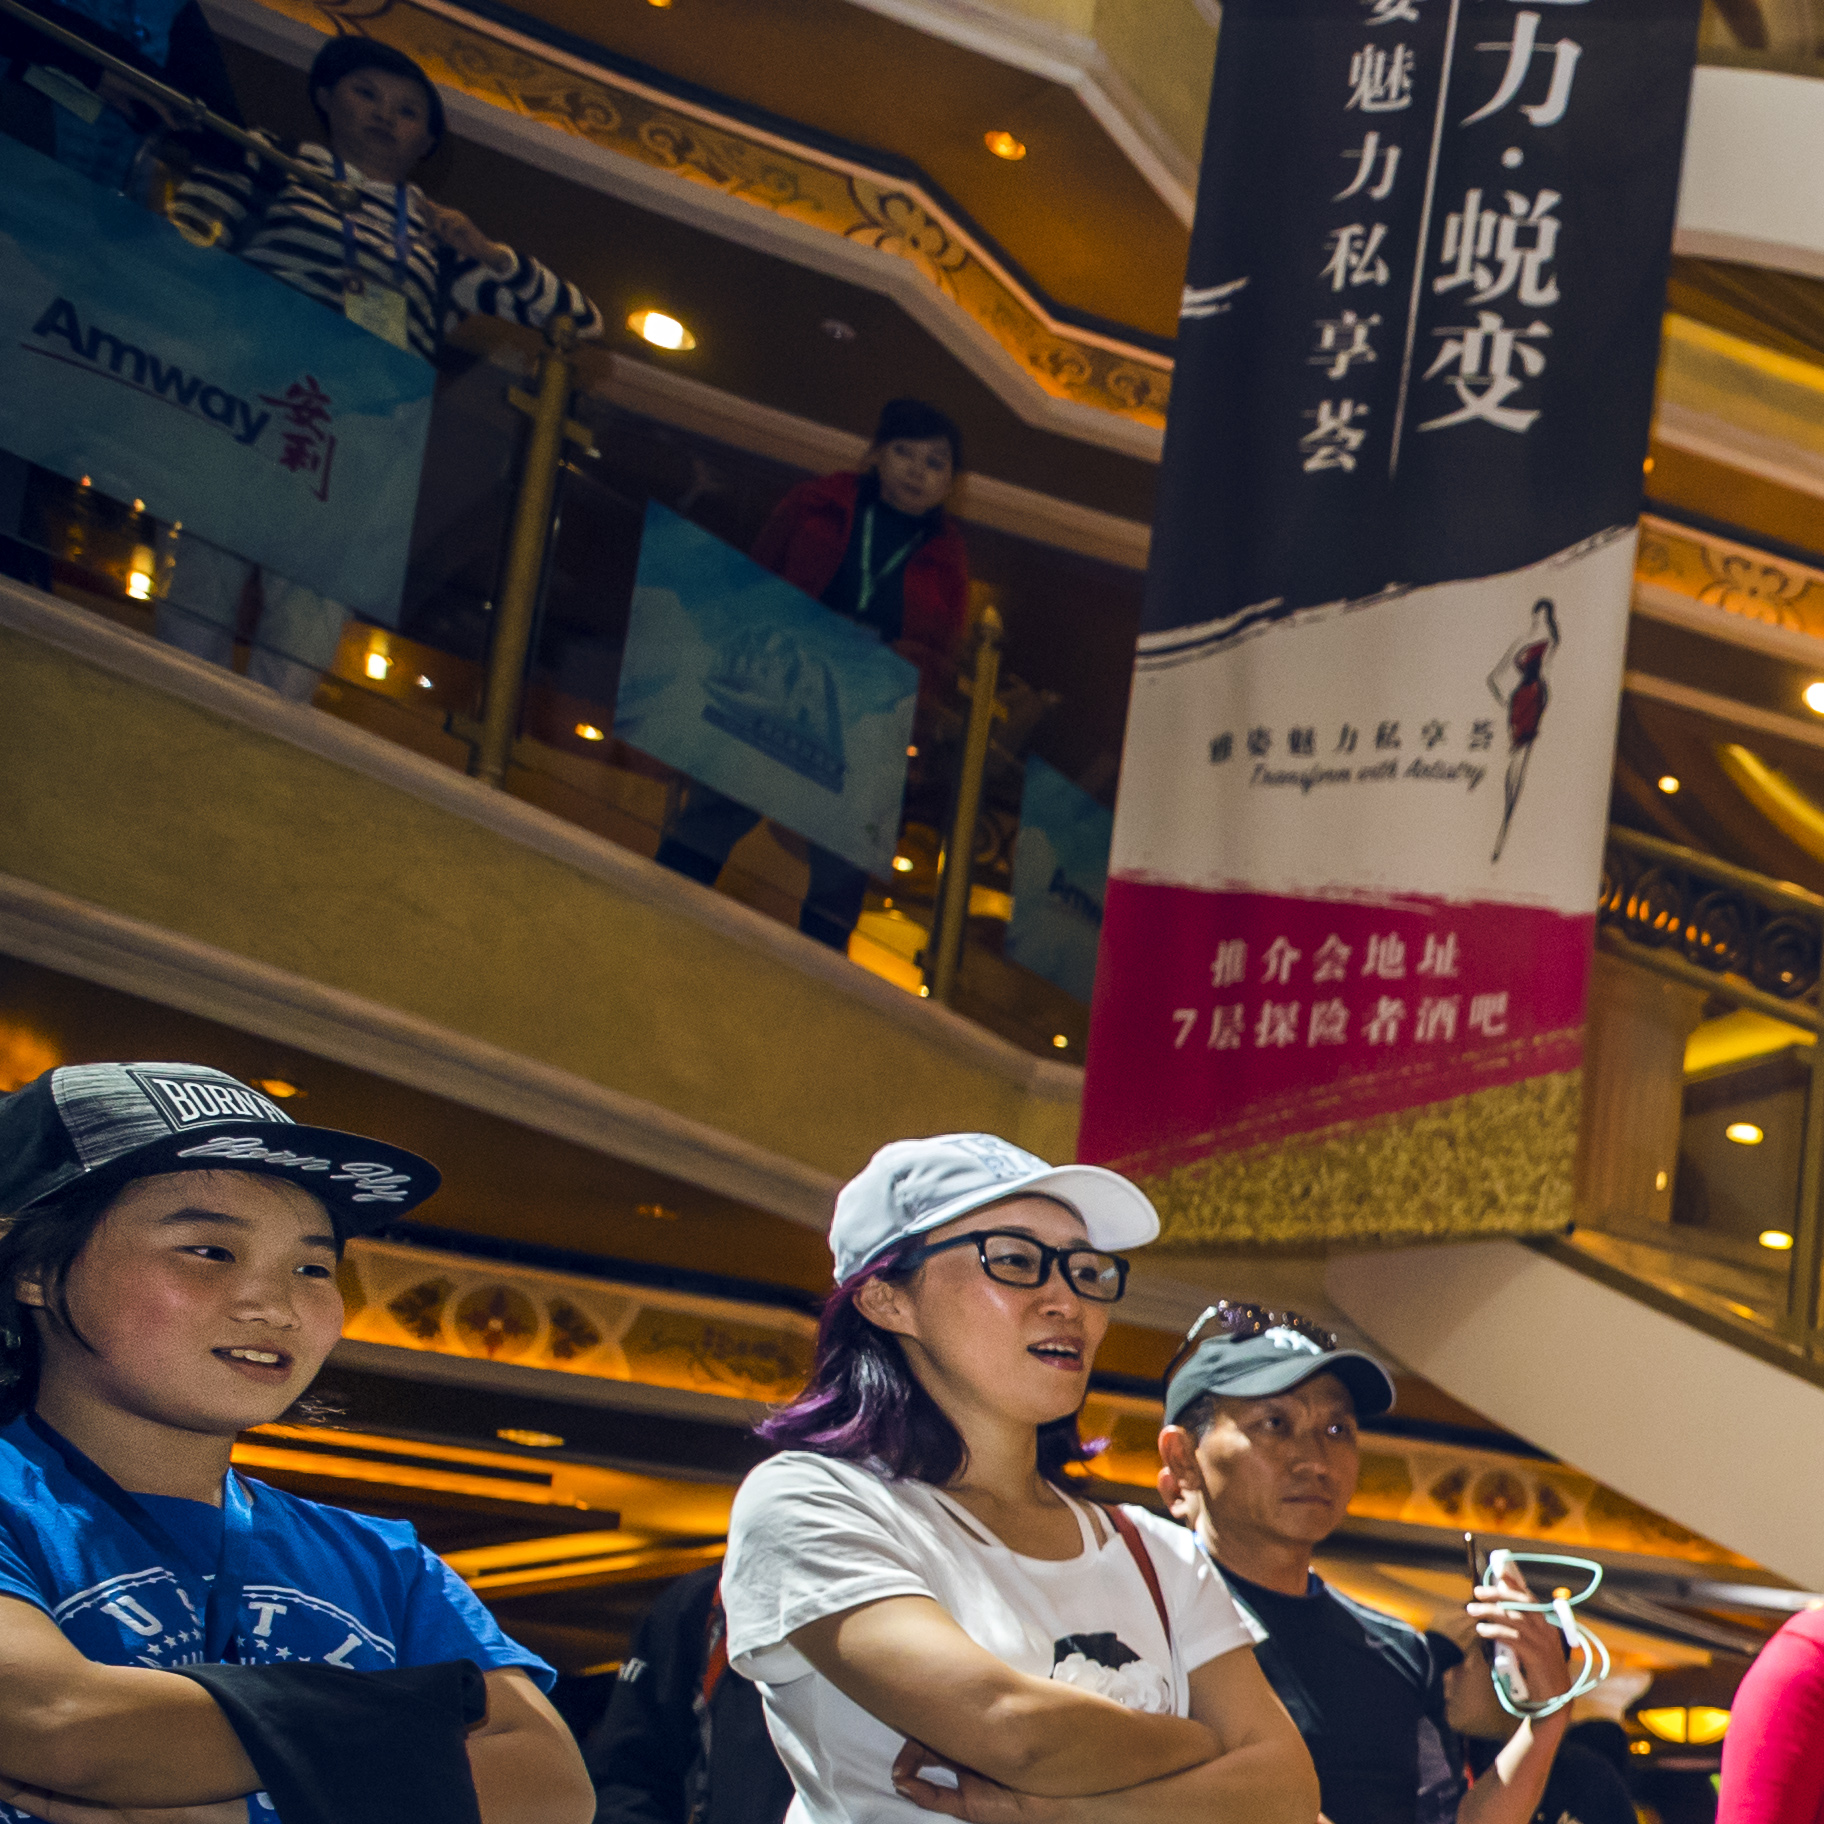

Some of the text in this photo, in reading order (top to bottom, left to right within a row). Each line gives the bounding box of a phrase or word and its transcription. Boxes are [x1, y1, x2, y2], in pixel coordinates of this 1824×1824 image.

[1416, 0, 1591, 434] 力·蜕变
[32, 297, 271, 446] Amway
[258, 374, 337, 502] 安利
[1210, 931, 1459, 988] 推介会地址
[1173, 991, 1509, 1050] 7层探险者酒吧
[152, 1078, 265, 1123] BORN
